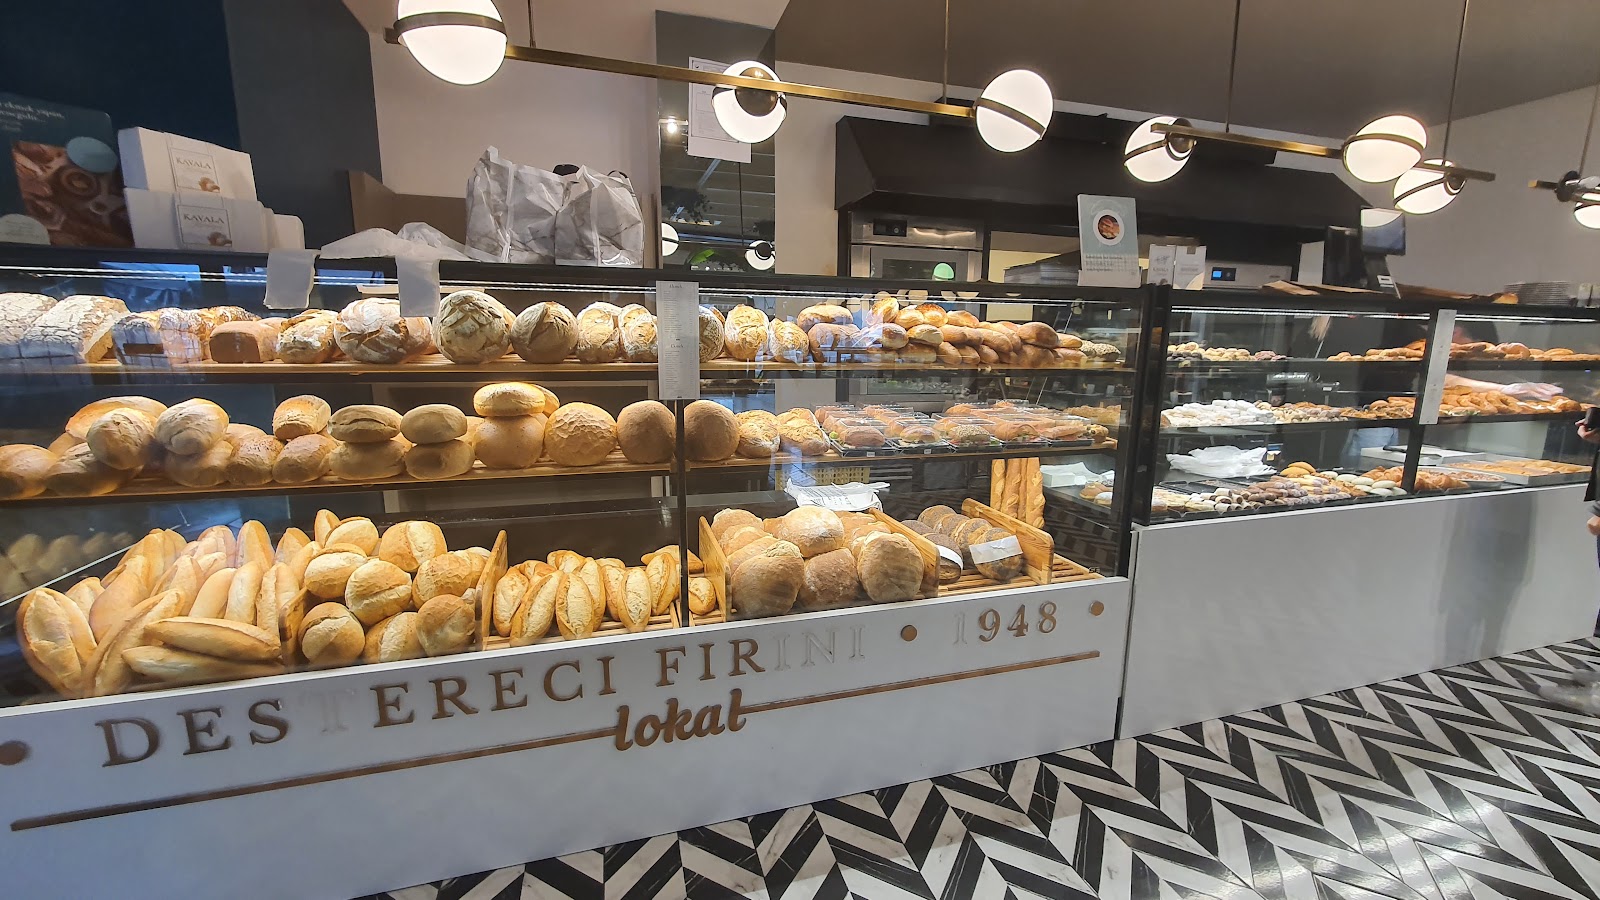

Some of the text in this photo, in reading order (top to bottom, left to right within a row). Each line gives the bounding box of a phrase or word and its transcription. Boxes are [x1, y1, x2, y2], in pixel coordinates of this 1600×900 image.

[176, 157, 212, 170] KAVALA
[183, 213, 225, 225] KAVALA
[953, 602, 1058, 644] 1948
[614, 688, 746, 752] lokal
